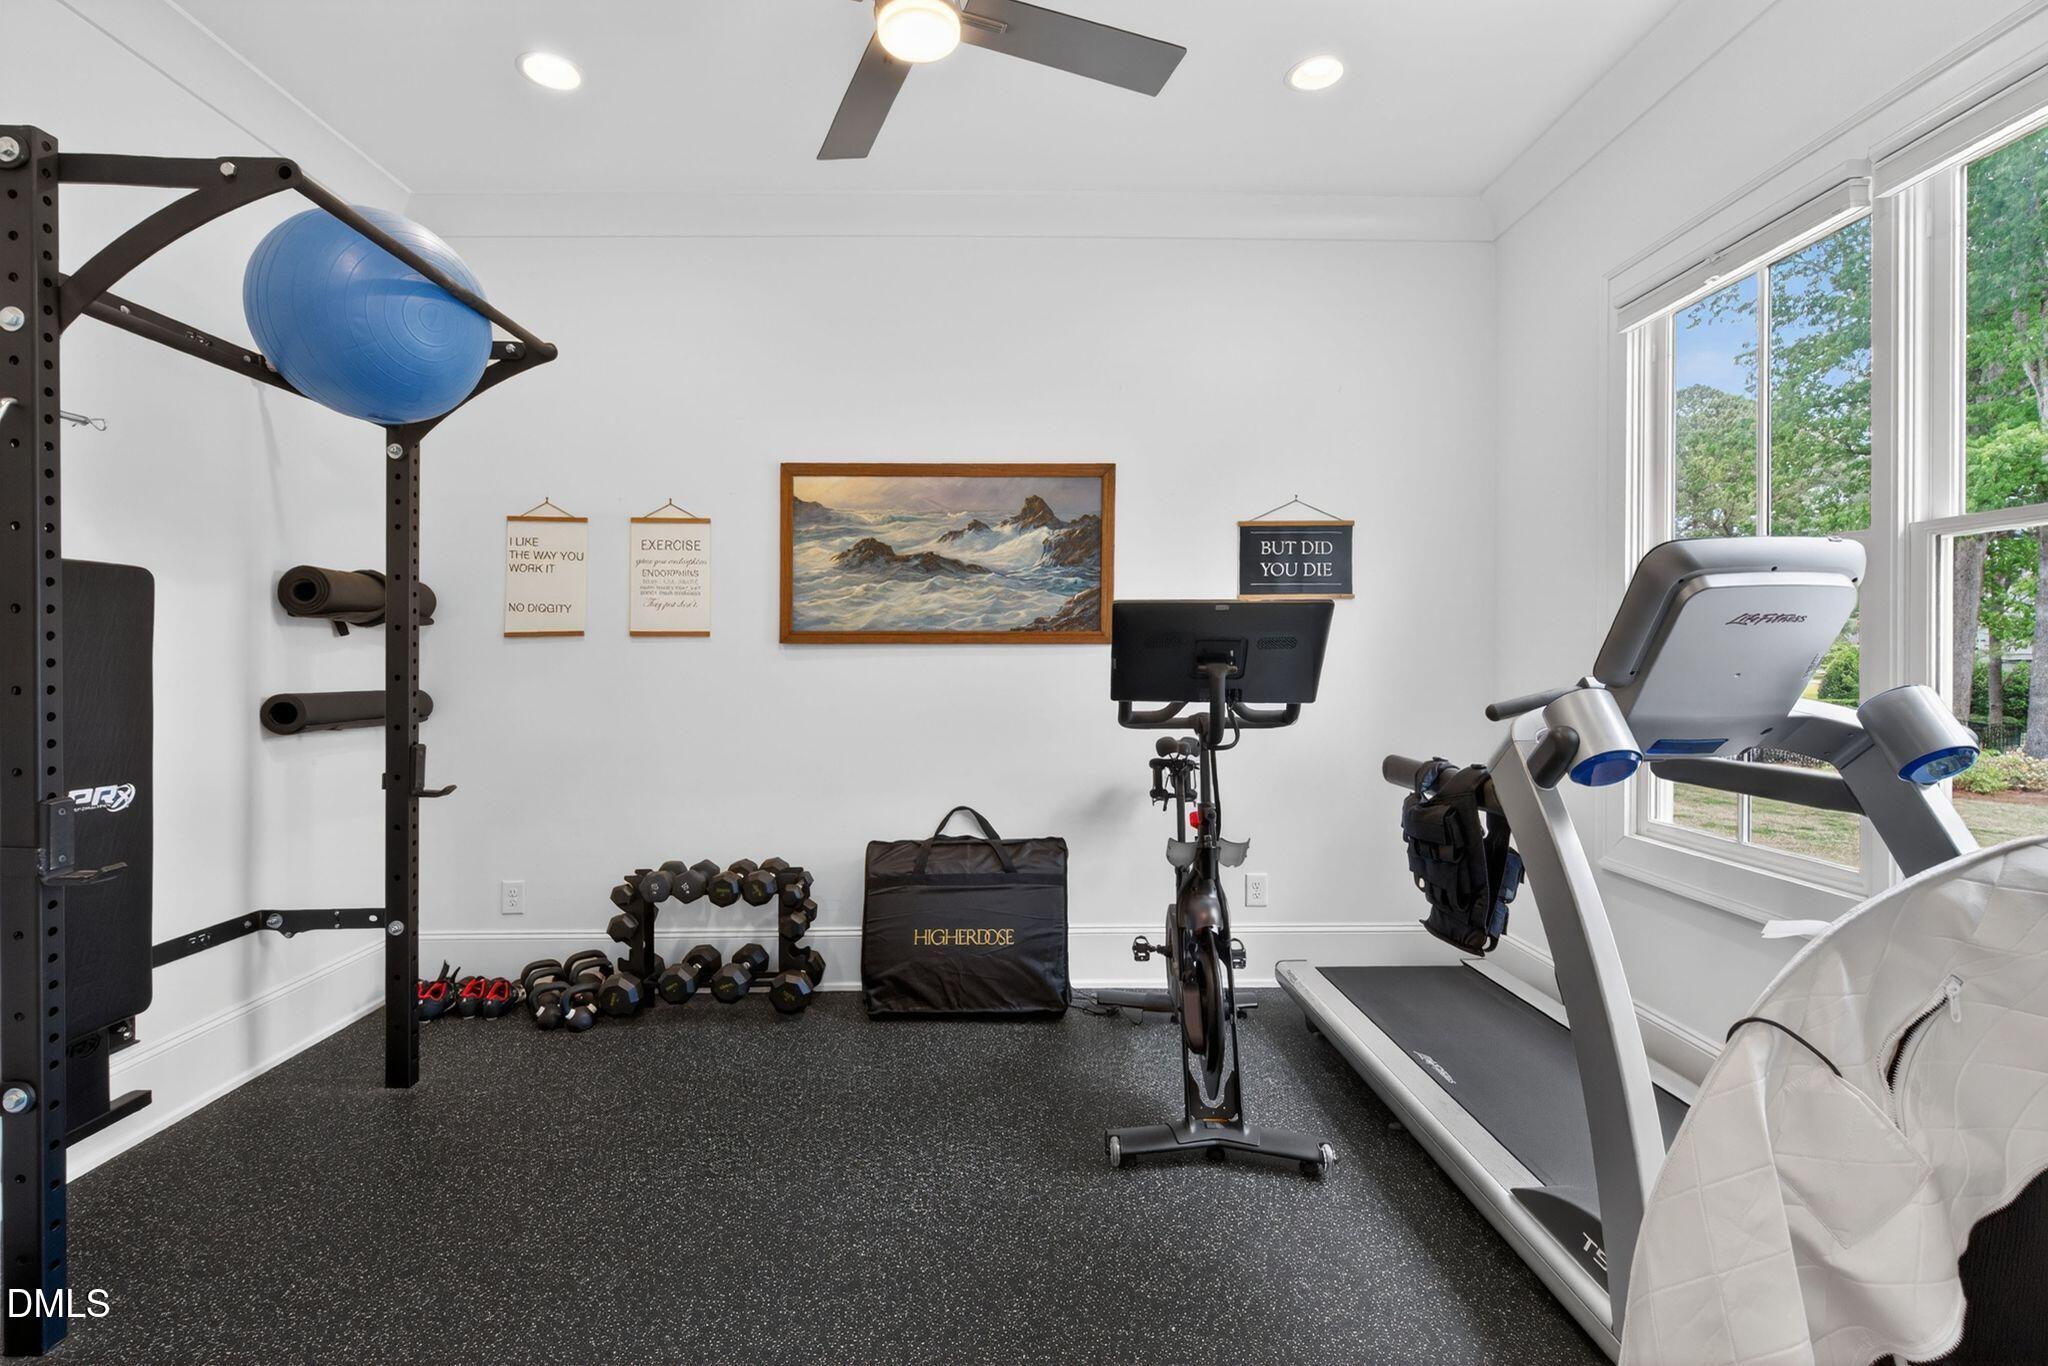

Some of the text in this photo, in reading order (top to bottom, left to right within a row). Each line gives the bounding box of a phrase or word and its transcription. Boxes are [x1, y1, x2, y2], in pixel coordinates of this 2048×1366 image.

[515, 537, 539, 547] LIKE
[641, 539, 702, 551] EXERCISE
[1260, 540, 1333, 555] BUT DID
[509, 550, 585, 562] THE WAY YOU
[509, 563, 556, 573] WORK IT
[1260, 562, 1333, 577] YOU DIE
[508, 602, 572, 614] NO DIGGITY
[913, 928, 1015, 946] HIGHERDOSE
